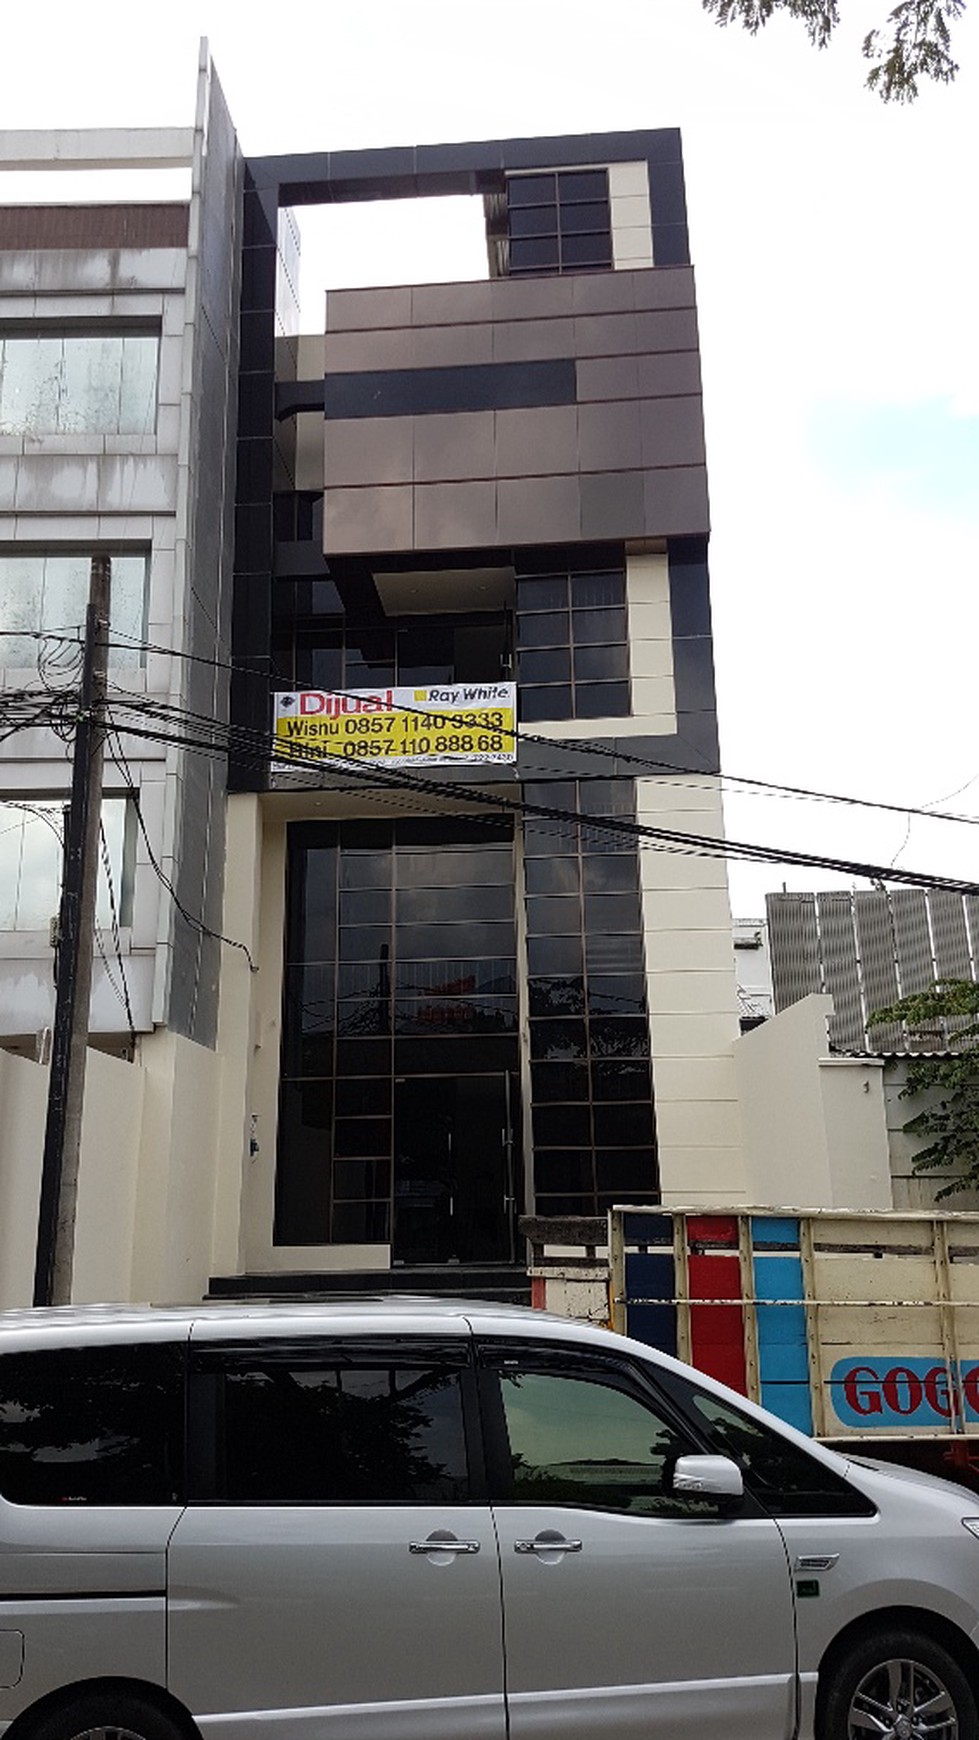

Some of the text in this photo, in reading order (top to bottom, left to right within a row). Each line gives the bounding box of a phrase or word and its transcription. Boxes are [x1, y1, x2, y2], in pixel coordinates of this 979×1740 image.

[300, 690, 392, 720] Dijual
[428, 687, 509, 704] Ray White
[287, 720, 339, 737] Wisnu
[345, 717, 396, 735] 0857
[402, 715, 446, 732] 1140
[343, 739, 394, 757] 0857
[400, 737, 431, 755] 110
[435, 735, 474, 752] 888
[477, 735, 503, 751] 68
